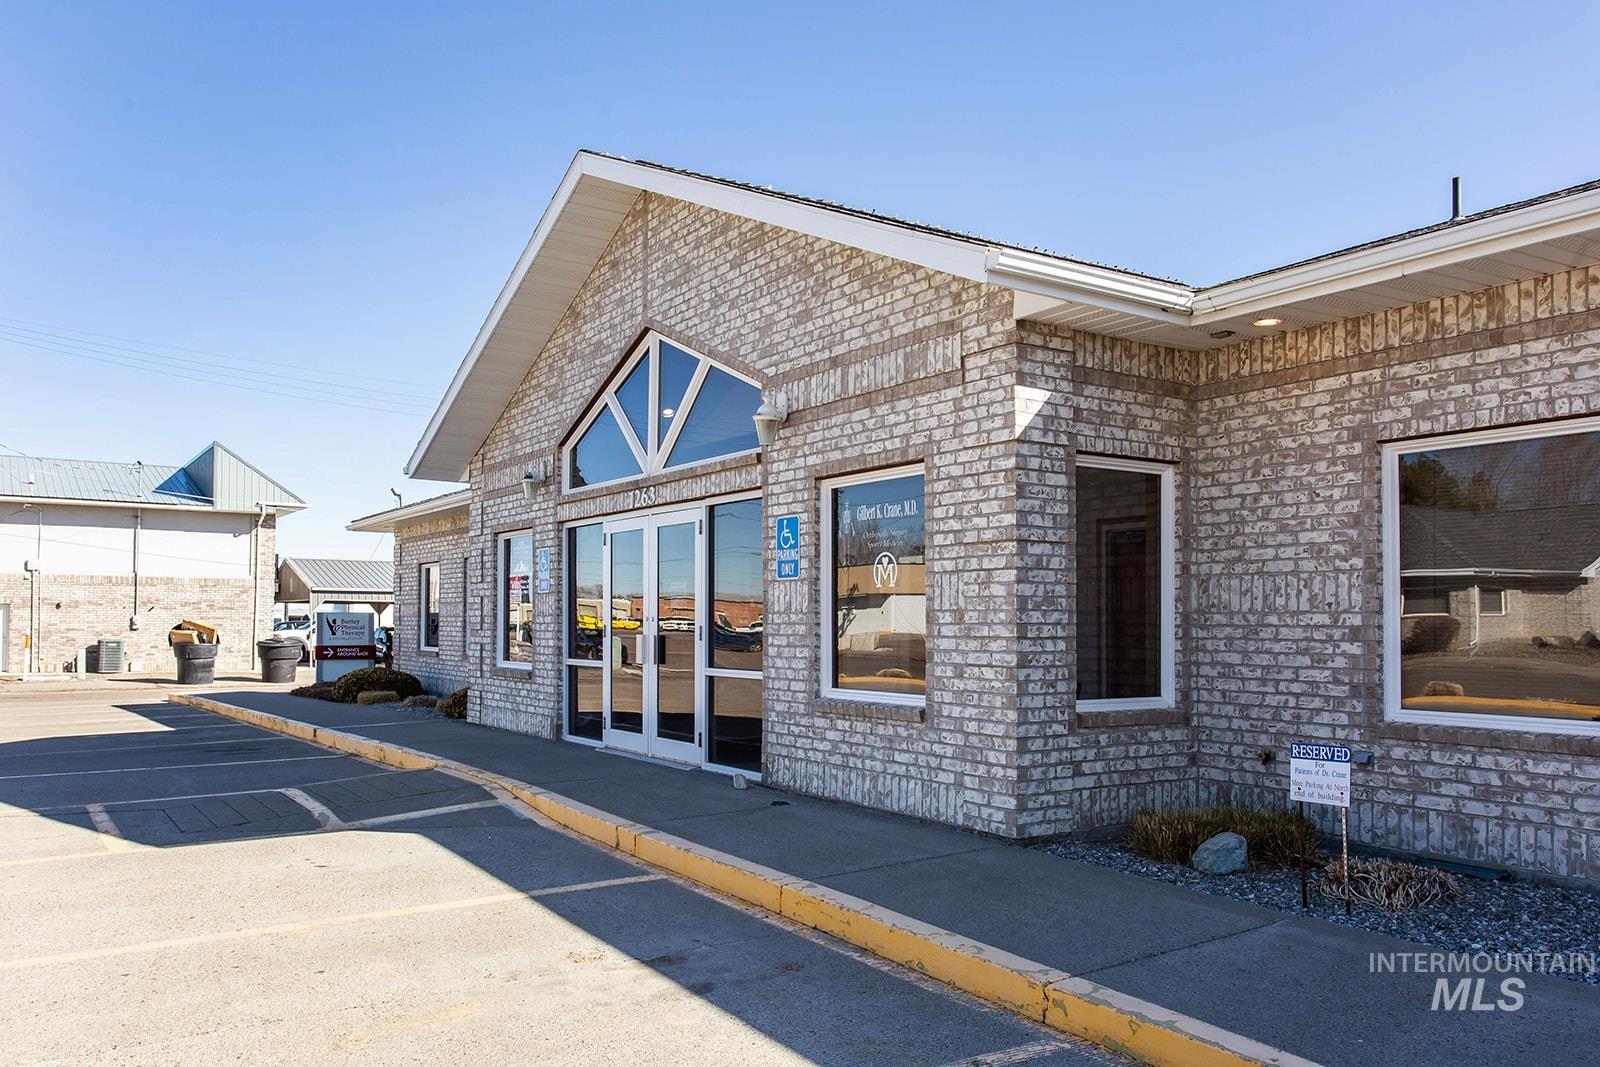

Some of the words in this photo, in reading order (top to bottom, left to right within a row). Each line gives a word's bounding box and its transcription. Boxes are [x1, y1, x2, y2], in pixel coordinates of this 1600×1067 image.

[856, 505, 875, 521] Gilbert
[884, 503, 903, 518] Crane,
[904, 500, 918, 516] M.D.
[340, 624, 366, 632] Physical
[1291, 744, 1350, 761] RESERVED
[1315, 761, 1326, 769] For
[1294, 767, 1313, 775] Patients
[1314, 768, 1321, 776] of
[1332, 770, 1347, 778] Crane
[1305, 780, 1323, 790] Parking
[1334, 783, 1349, 792] North
